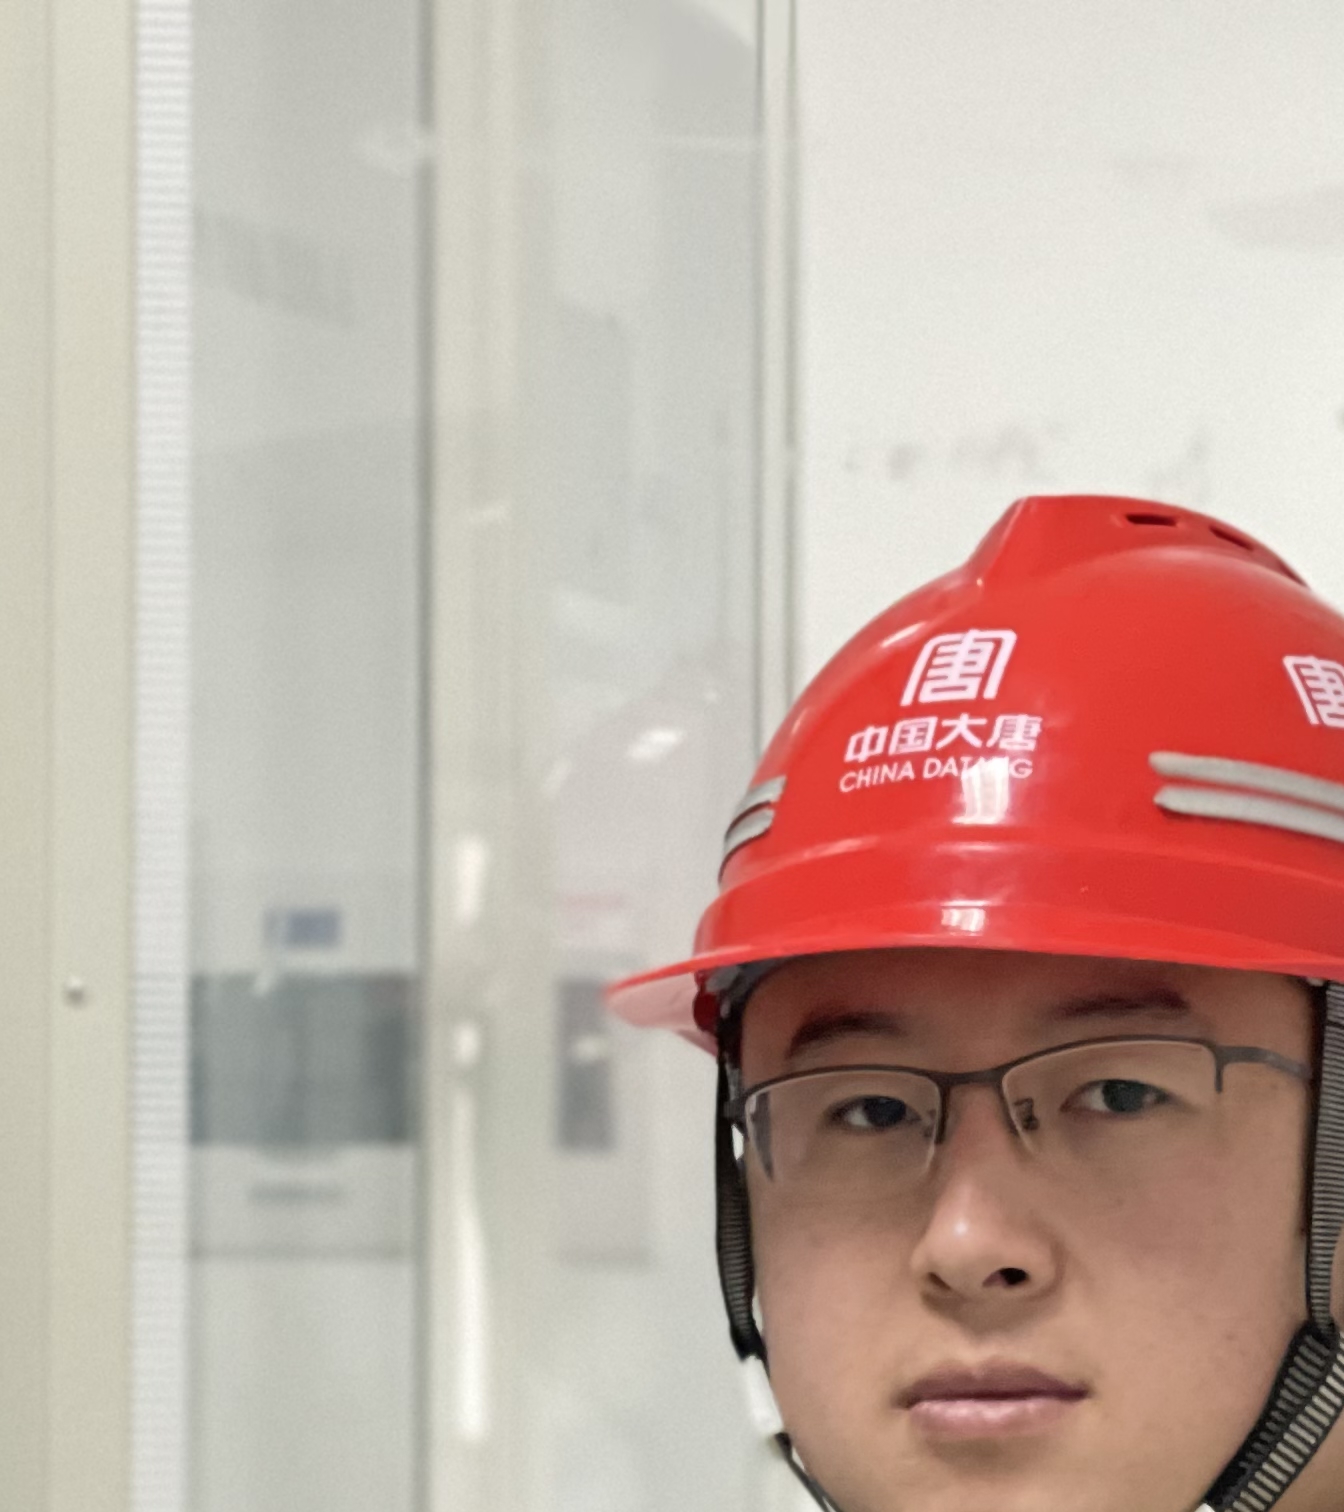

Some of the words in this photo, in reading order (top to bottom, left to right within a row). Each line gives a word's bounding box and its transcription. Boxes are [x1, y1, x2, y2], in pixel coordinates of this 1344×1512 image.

[843, 713, 1043, 763] 中国大唐
[839, 758, 915, 793] CHINA
[923, 755, 1033, 781] DATG
